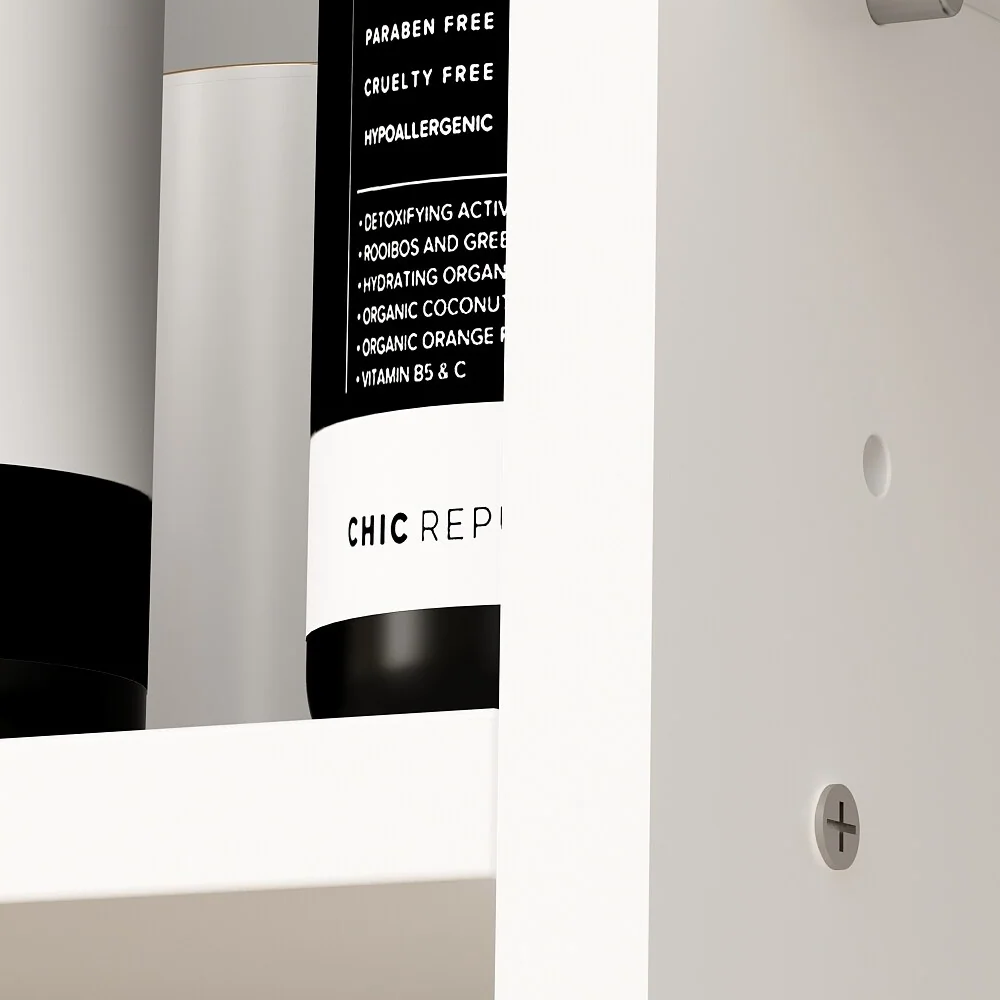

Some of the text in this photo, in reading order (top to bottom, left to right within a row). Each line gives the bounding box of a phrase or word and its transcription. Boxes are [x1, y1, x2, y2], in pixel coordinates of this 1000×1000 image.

[366, 12, 494, 45] PARABEN FREE
[364, 63, 493, 96] CRUELTY FREE
[365, 114, 492, 145] HYPOALLERGENIC
[365, 204, 453, 231] DETOXIFYING
[364, 238, 419, 261] ROOIBOS
[424, 235, 458, 253] AND
[364, 268, 437, 293] HYDRATING
[363, 302, 417, 325] ORGANIC
[363, 333, 417, 356] ORGANIC
[423, 327, 493, 349] ORANGE
[362, 361, 465, 387] VITAMIN B5 & C
[349, 507, 502, 547] CHIC REP
